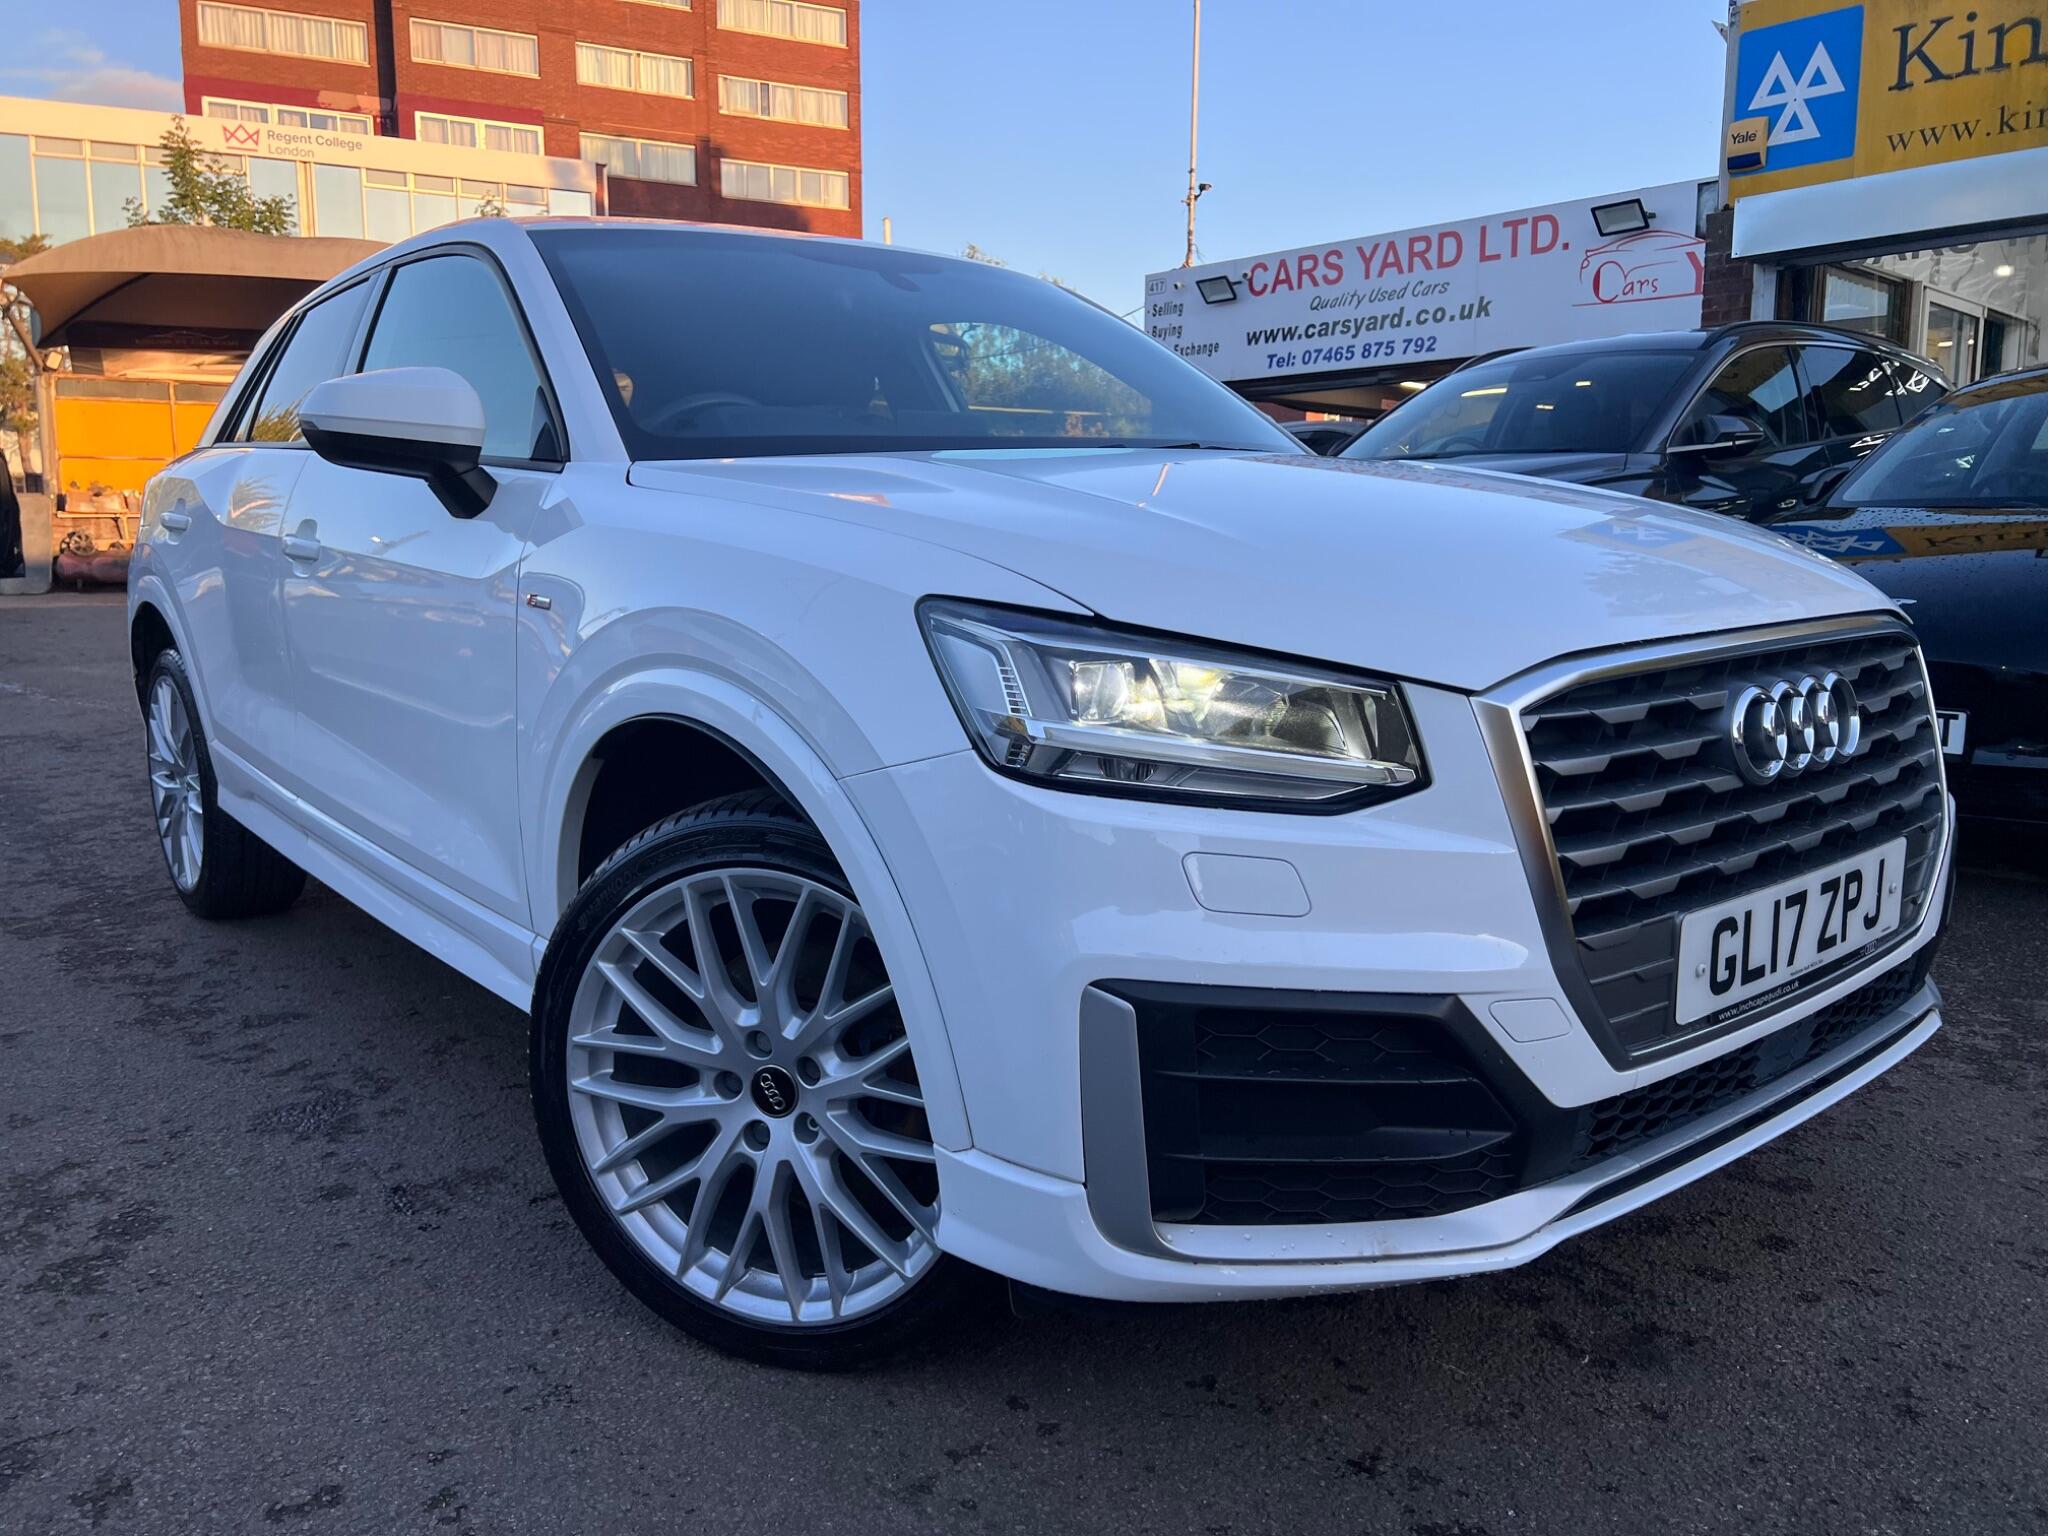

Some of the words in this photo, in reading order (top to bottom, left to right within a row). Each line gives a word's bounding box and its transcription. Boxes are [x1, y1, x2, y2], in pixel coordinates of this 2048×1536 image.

[1888, 11, 2048, 91] Kin
[267, 129, 312, 145] Regent
[316, 134, 362, 151] College
[268, 144, 315, 158] London
[1731, 131, 1757, 144] Yale
[1248, 249, 1344, 297] CARS
[1356, 230, 1463, 280] YARD
[1479, 214, 1569, 263] LTD.
[1149, 281, 1164, 292] 417
[1310, 290, 1367, 311] Quality
[1369, 281, 1409, 303] Used
[1411, 280, 1450, 296] Cars
[1593, 260, 1659, 303] Cars
[1152, 301, 1184, 317] Selling
[1246, 296, 1493, 346] www.carsyard.co.uk
[1152, 323, 1182, 340] Buying
[1267, 352, 1296, 369] Tel:
[1302, 345, 1355, 365] 07465
[1361, 340, 1395, 359] 875
[1402, 336, 1438, 355] 792
[1709, 888, 1808, 996] GL17
[1817, 858, 1886, 954] ZPJ
